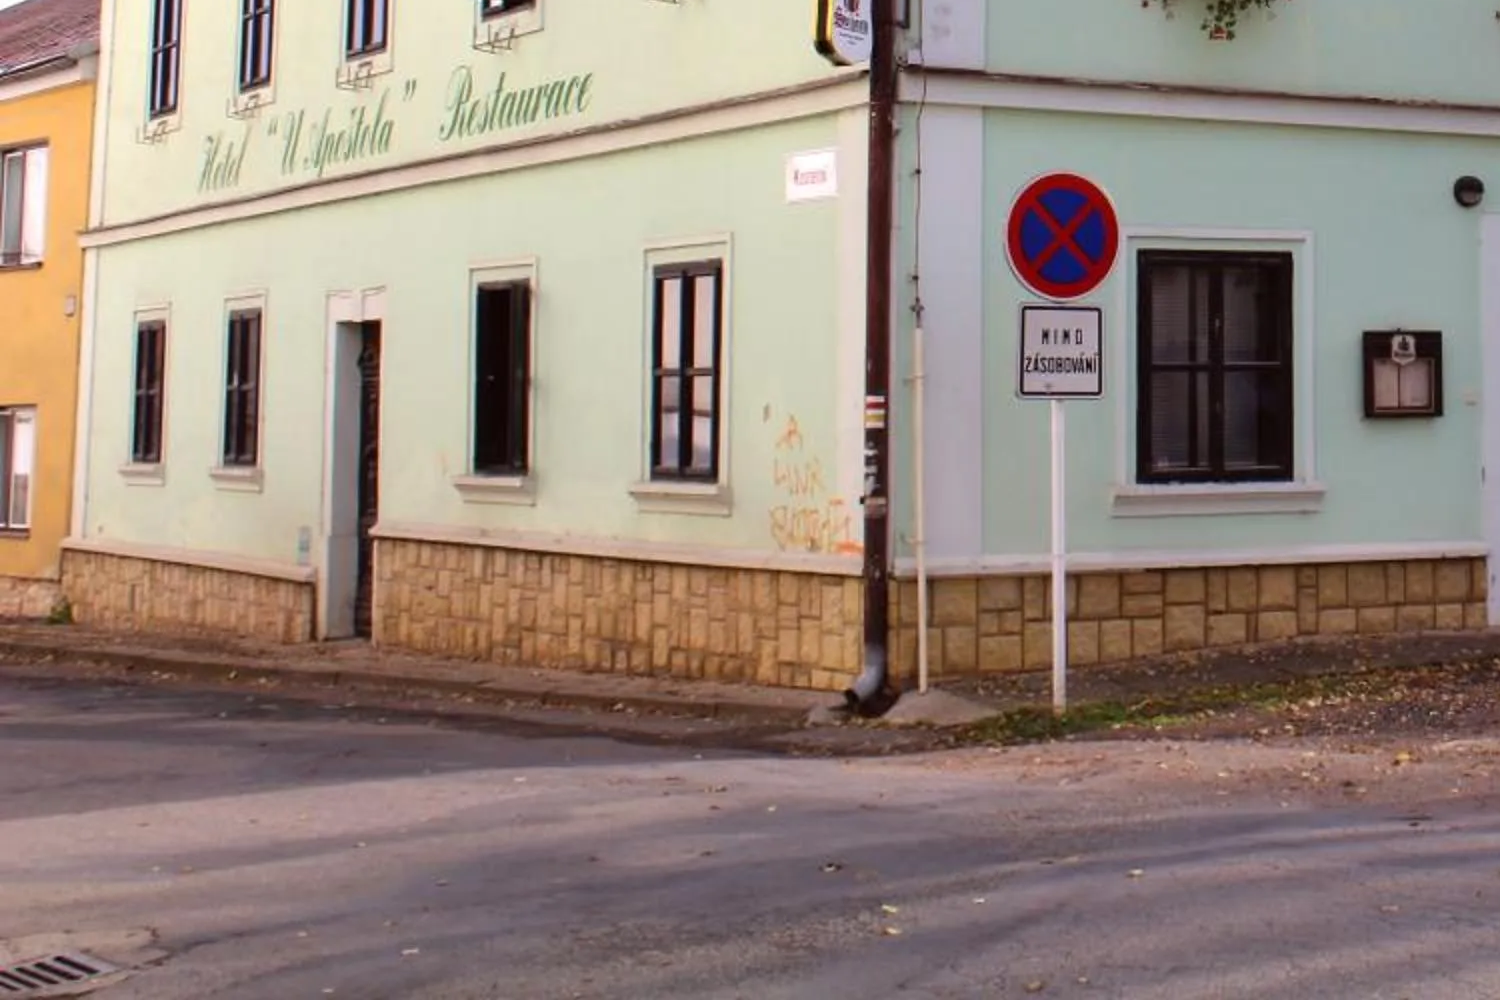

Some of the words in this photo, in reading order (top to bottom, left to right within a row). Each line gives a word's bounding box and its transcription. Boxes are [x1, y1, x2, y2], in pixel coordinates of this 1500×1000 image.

[438, 65, 593, 142] Restaurace
[1041, 328, 1083, 345] MIMO
[1024, 352, 1100, 374] ZÁSOBOVÁNÍ
